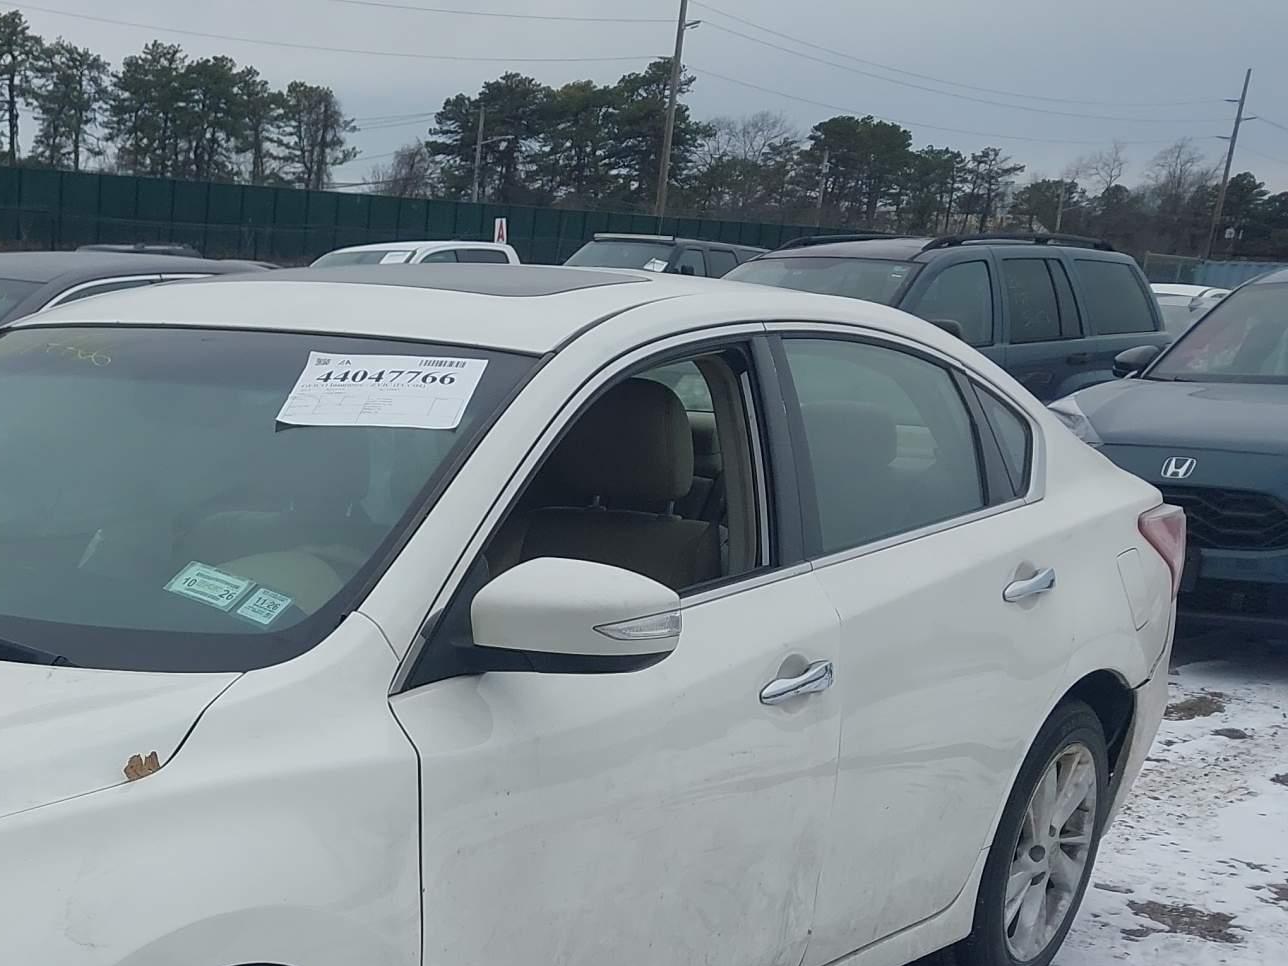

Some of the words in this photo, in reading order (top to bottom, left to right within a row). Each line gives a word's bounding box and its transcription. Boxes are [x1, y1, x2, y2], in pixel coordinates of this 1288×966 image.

[497, 219, 505, 242] A
[316, 369, 456, 385] 44047766
[182, 576, 198, 587] 10
[218, 589, 237, 601] 26
